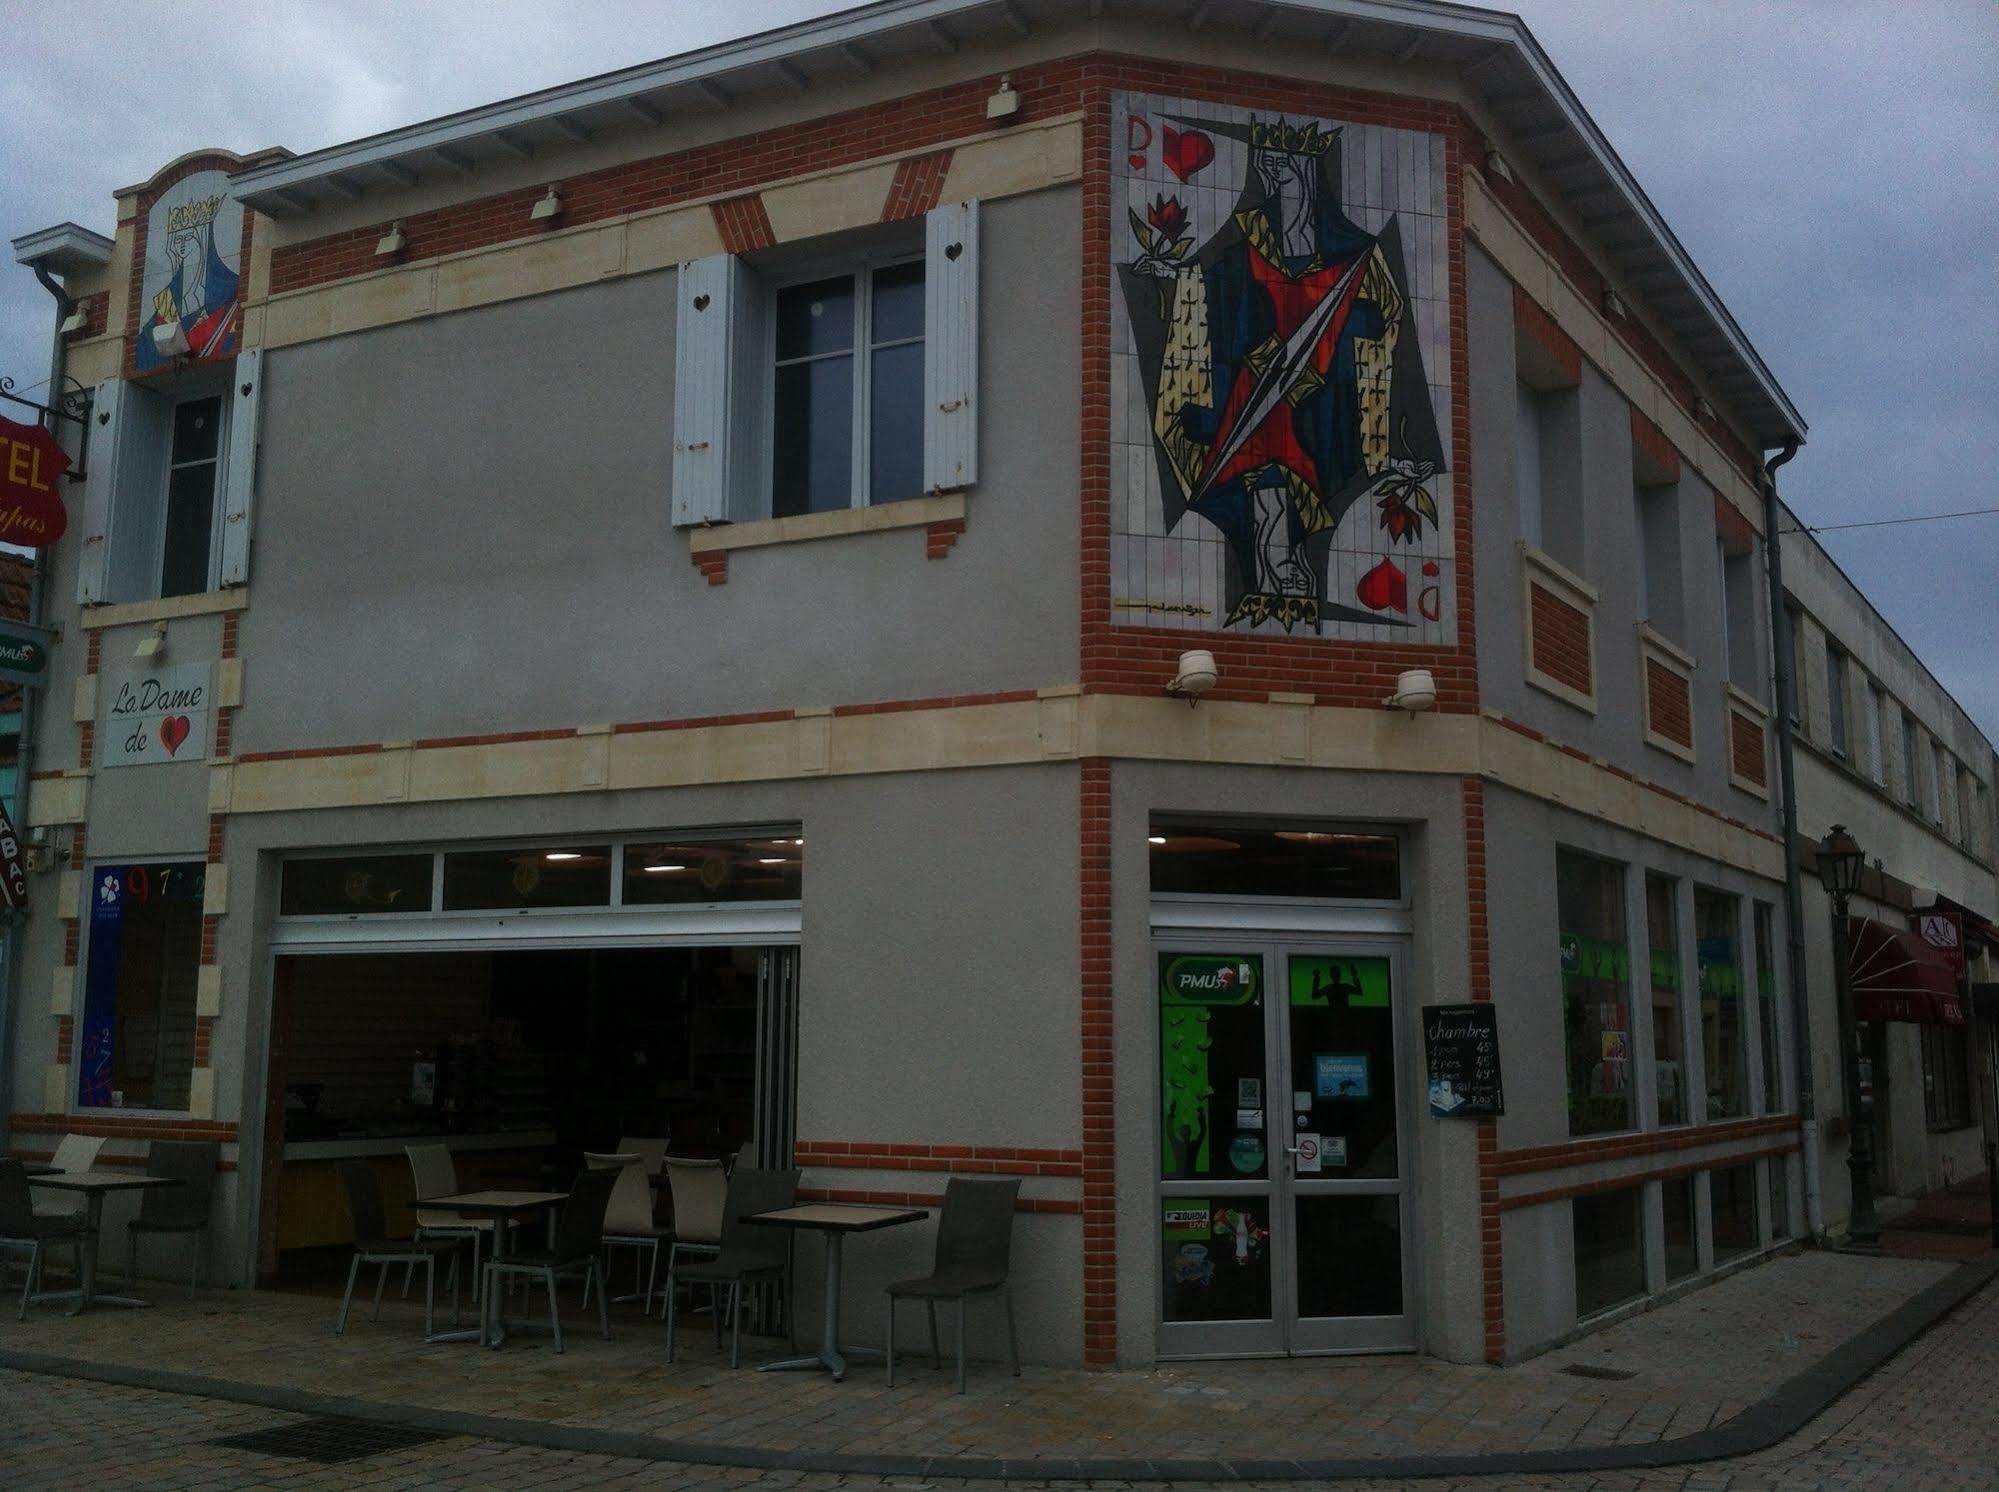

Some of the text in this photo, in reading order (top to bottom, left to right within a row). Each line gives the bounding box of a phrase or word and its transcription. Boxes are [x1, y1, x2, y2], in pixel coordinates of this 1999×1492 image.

[1127, 114, 1152, 152] D
[112, 679, 202, 714] La Dame
[125, 721, 147, 753] de
[0, 810, 25, 895] ABAC
[1179, 974, 1217, 989] PMU
